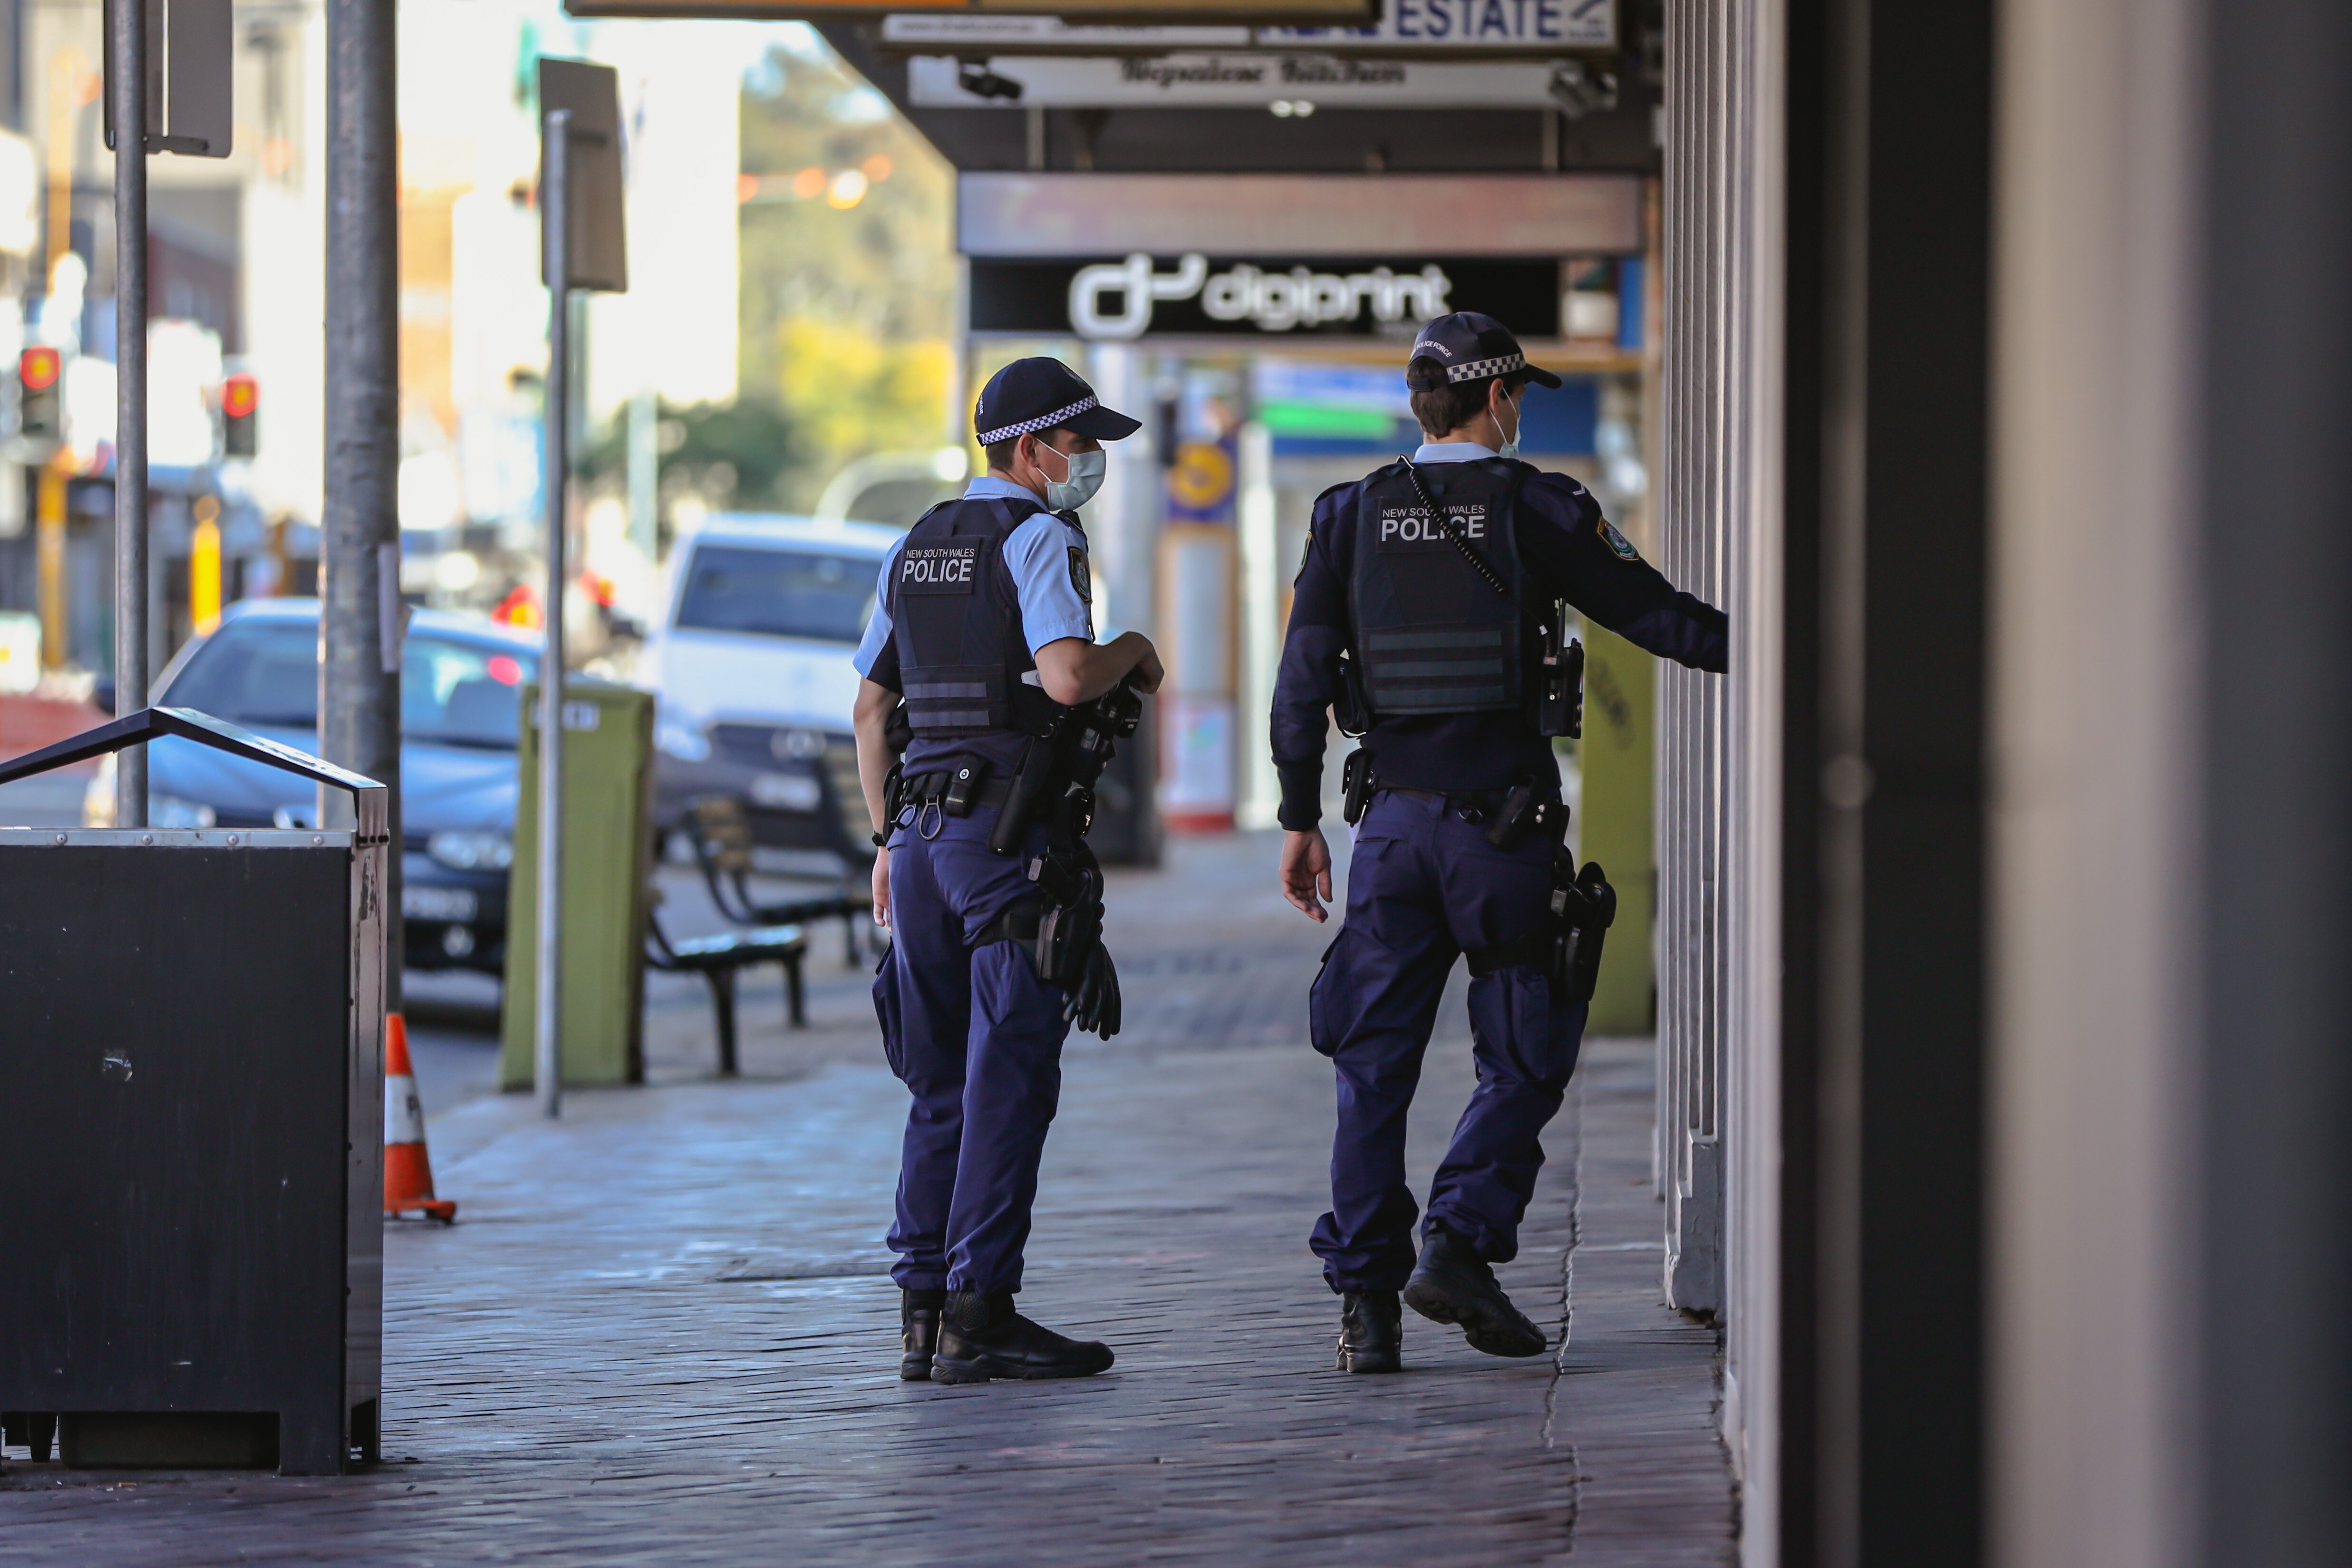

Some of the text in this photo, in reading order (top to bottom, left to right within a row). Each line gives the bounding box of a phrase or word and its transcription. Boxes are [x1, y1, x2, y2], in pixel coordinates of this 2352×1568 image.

[1395, 0, 1562, 38] ESTATE
[1200, 263, 1452, 331] digiprint
[1432, 341, 1452, 358] FORCE
[1383, 508, 1407, 517] NEW
[1449, 505, 1485, 514] WALES
[906, 548, 975, 558] NEW SOUTH WALES
[901, 559, 973, 583] POLICE
